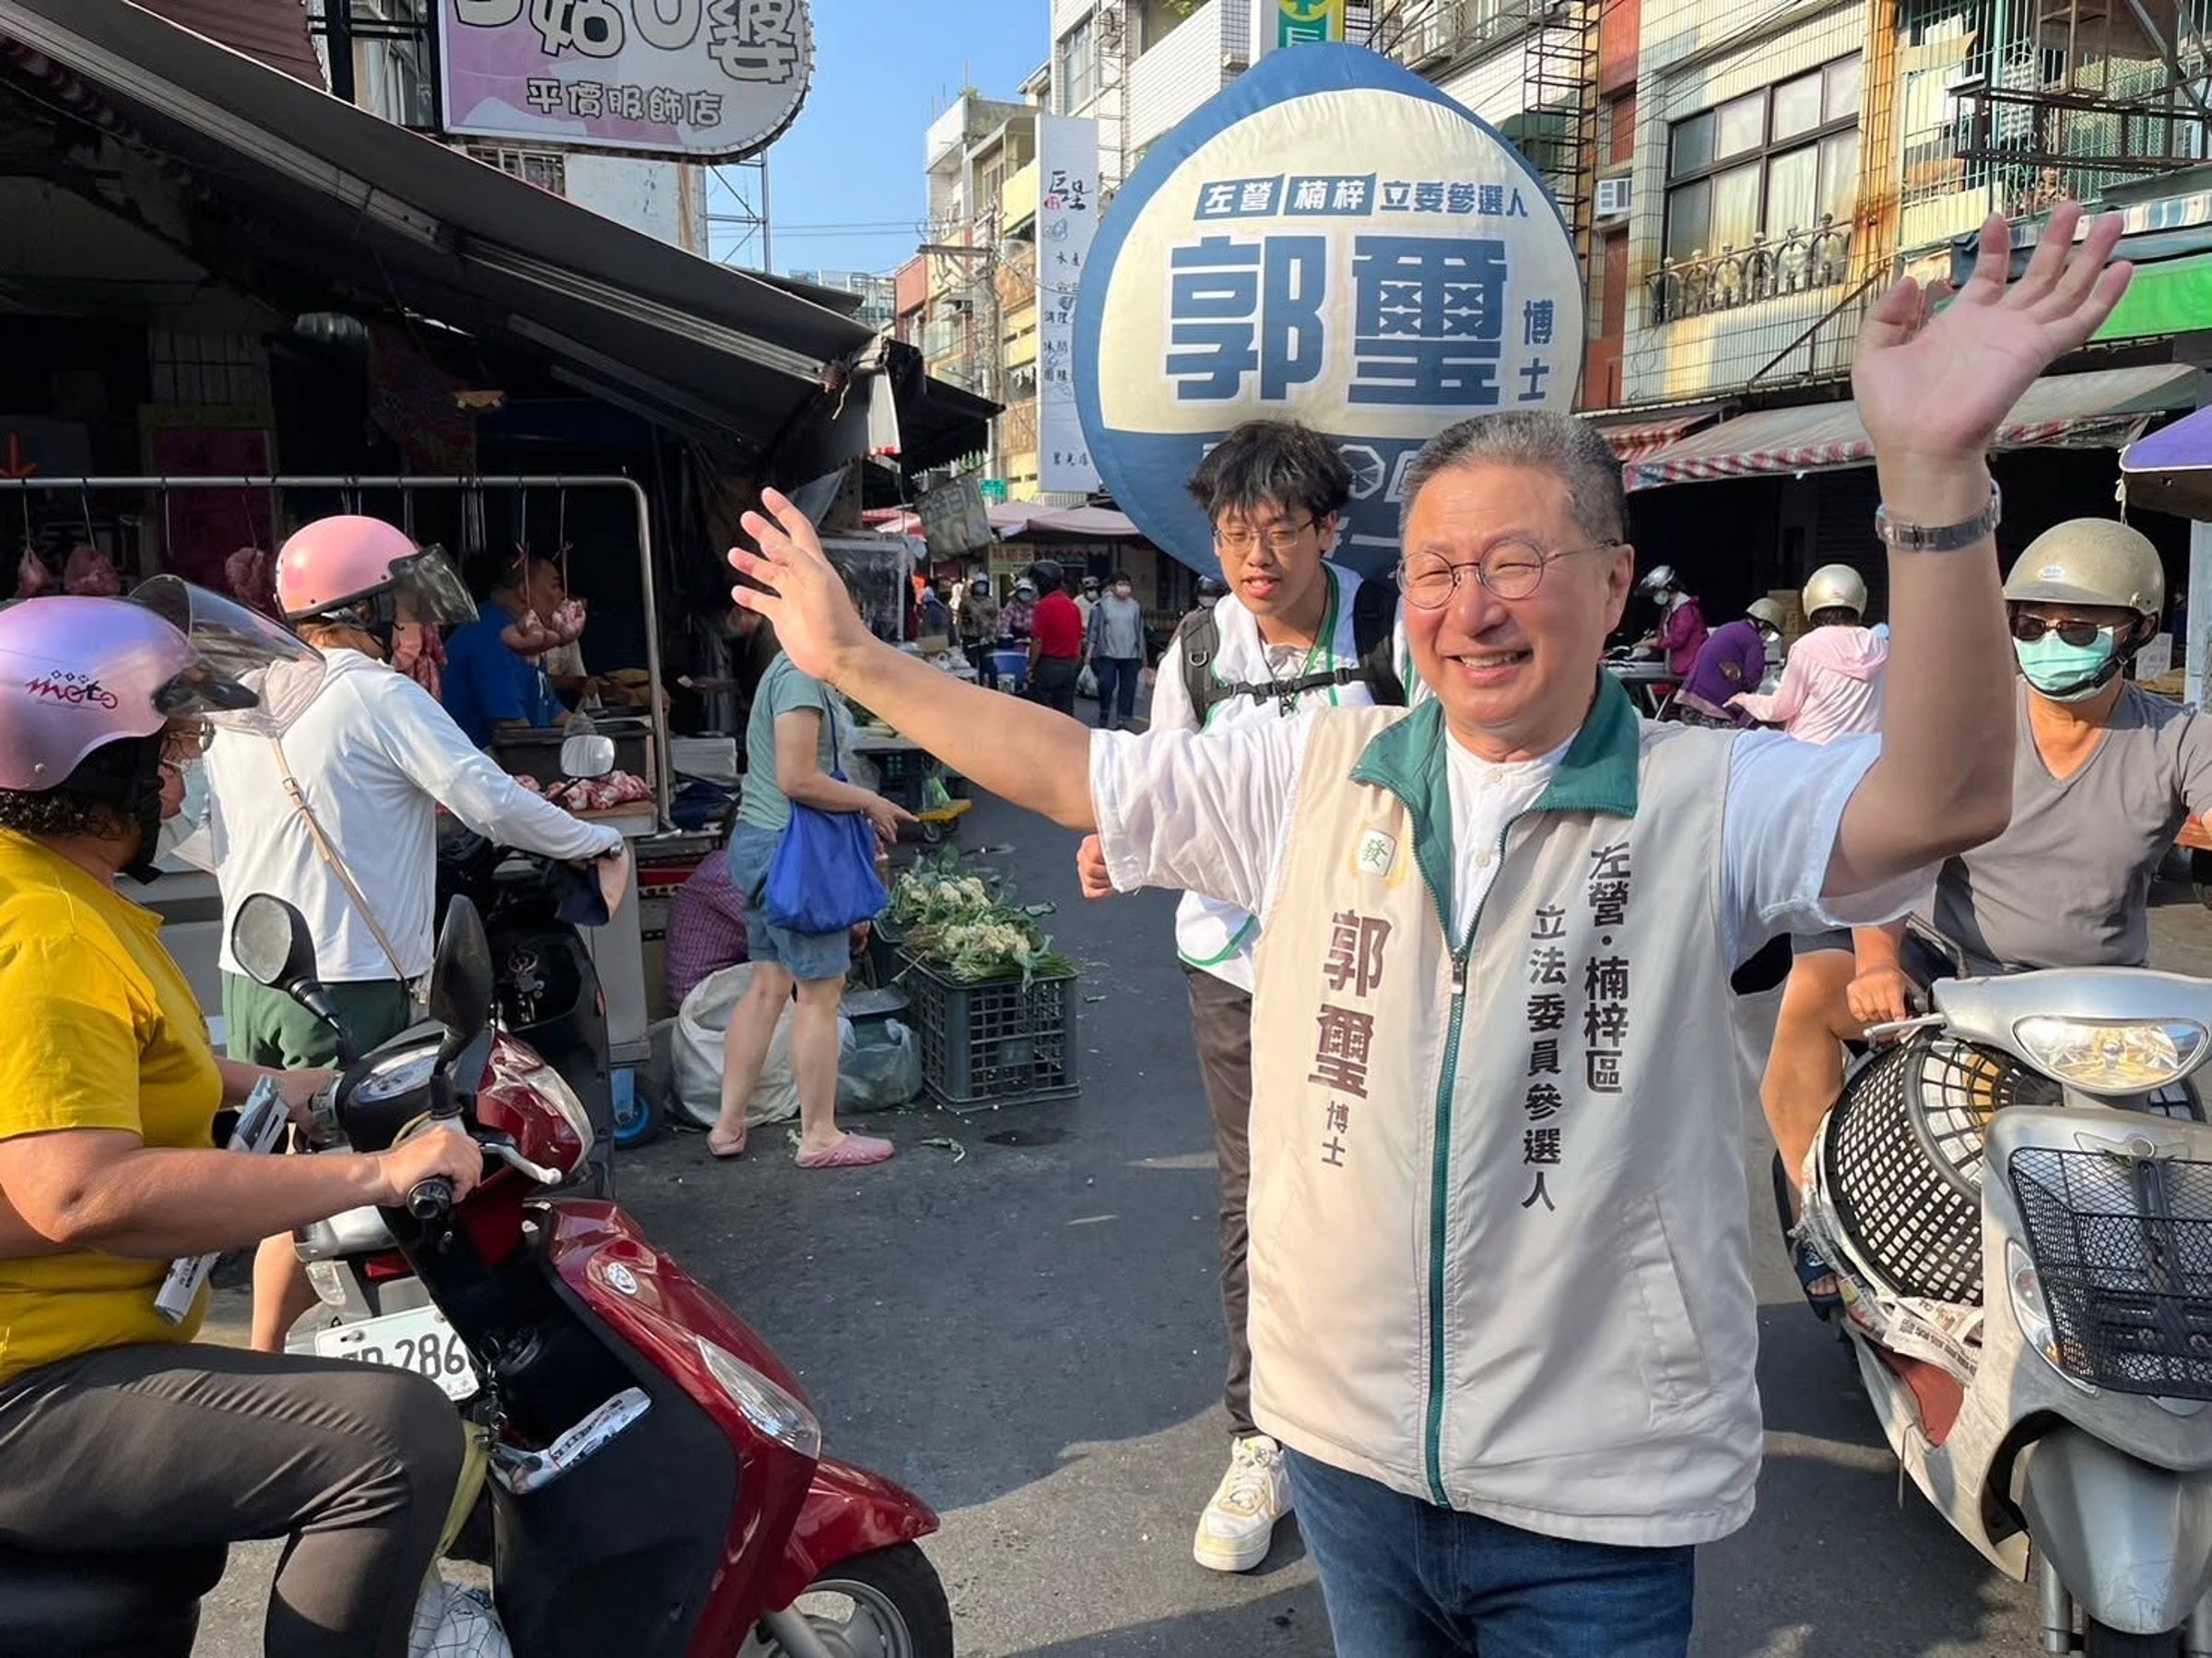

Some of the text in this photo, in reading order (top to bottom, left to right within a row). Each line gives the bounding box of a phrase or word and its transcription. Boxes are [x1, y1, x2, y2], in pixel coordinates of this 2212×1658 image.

[526, 78, 723, 126] 平價服飾店
[1204, 180, 1529, 218] 左營 楠梓 立委參選人
[1166, 234, 1507, 406] 郭璽
[1518, 300, 1554, 402] 博士
[1522, 903, 1568, 1212] 立法委員參選人
[1321, 1100, 1351, 1169] 博士
